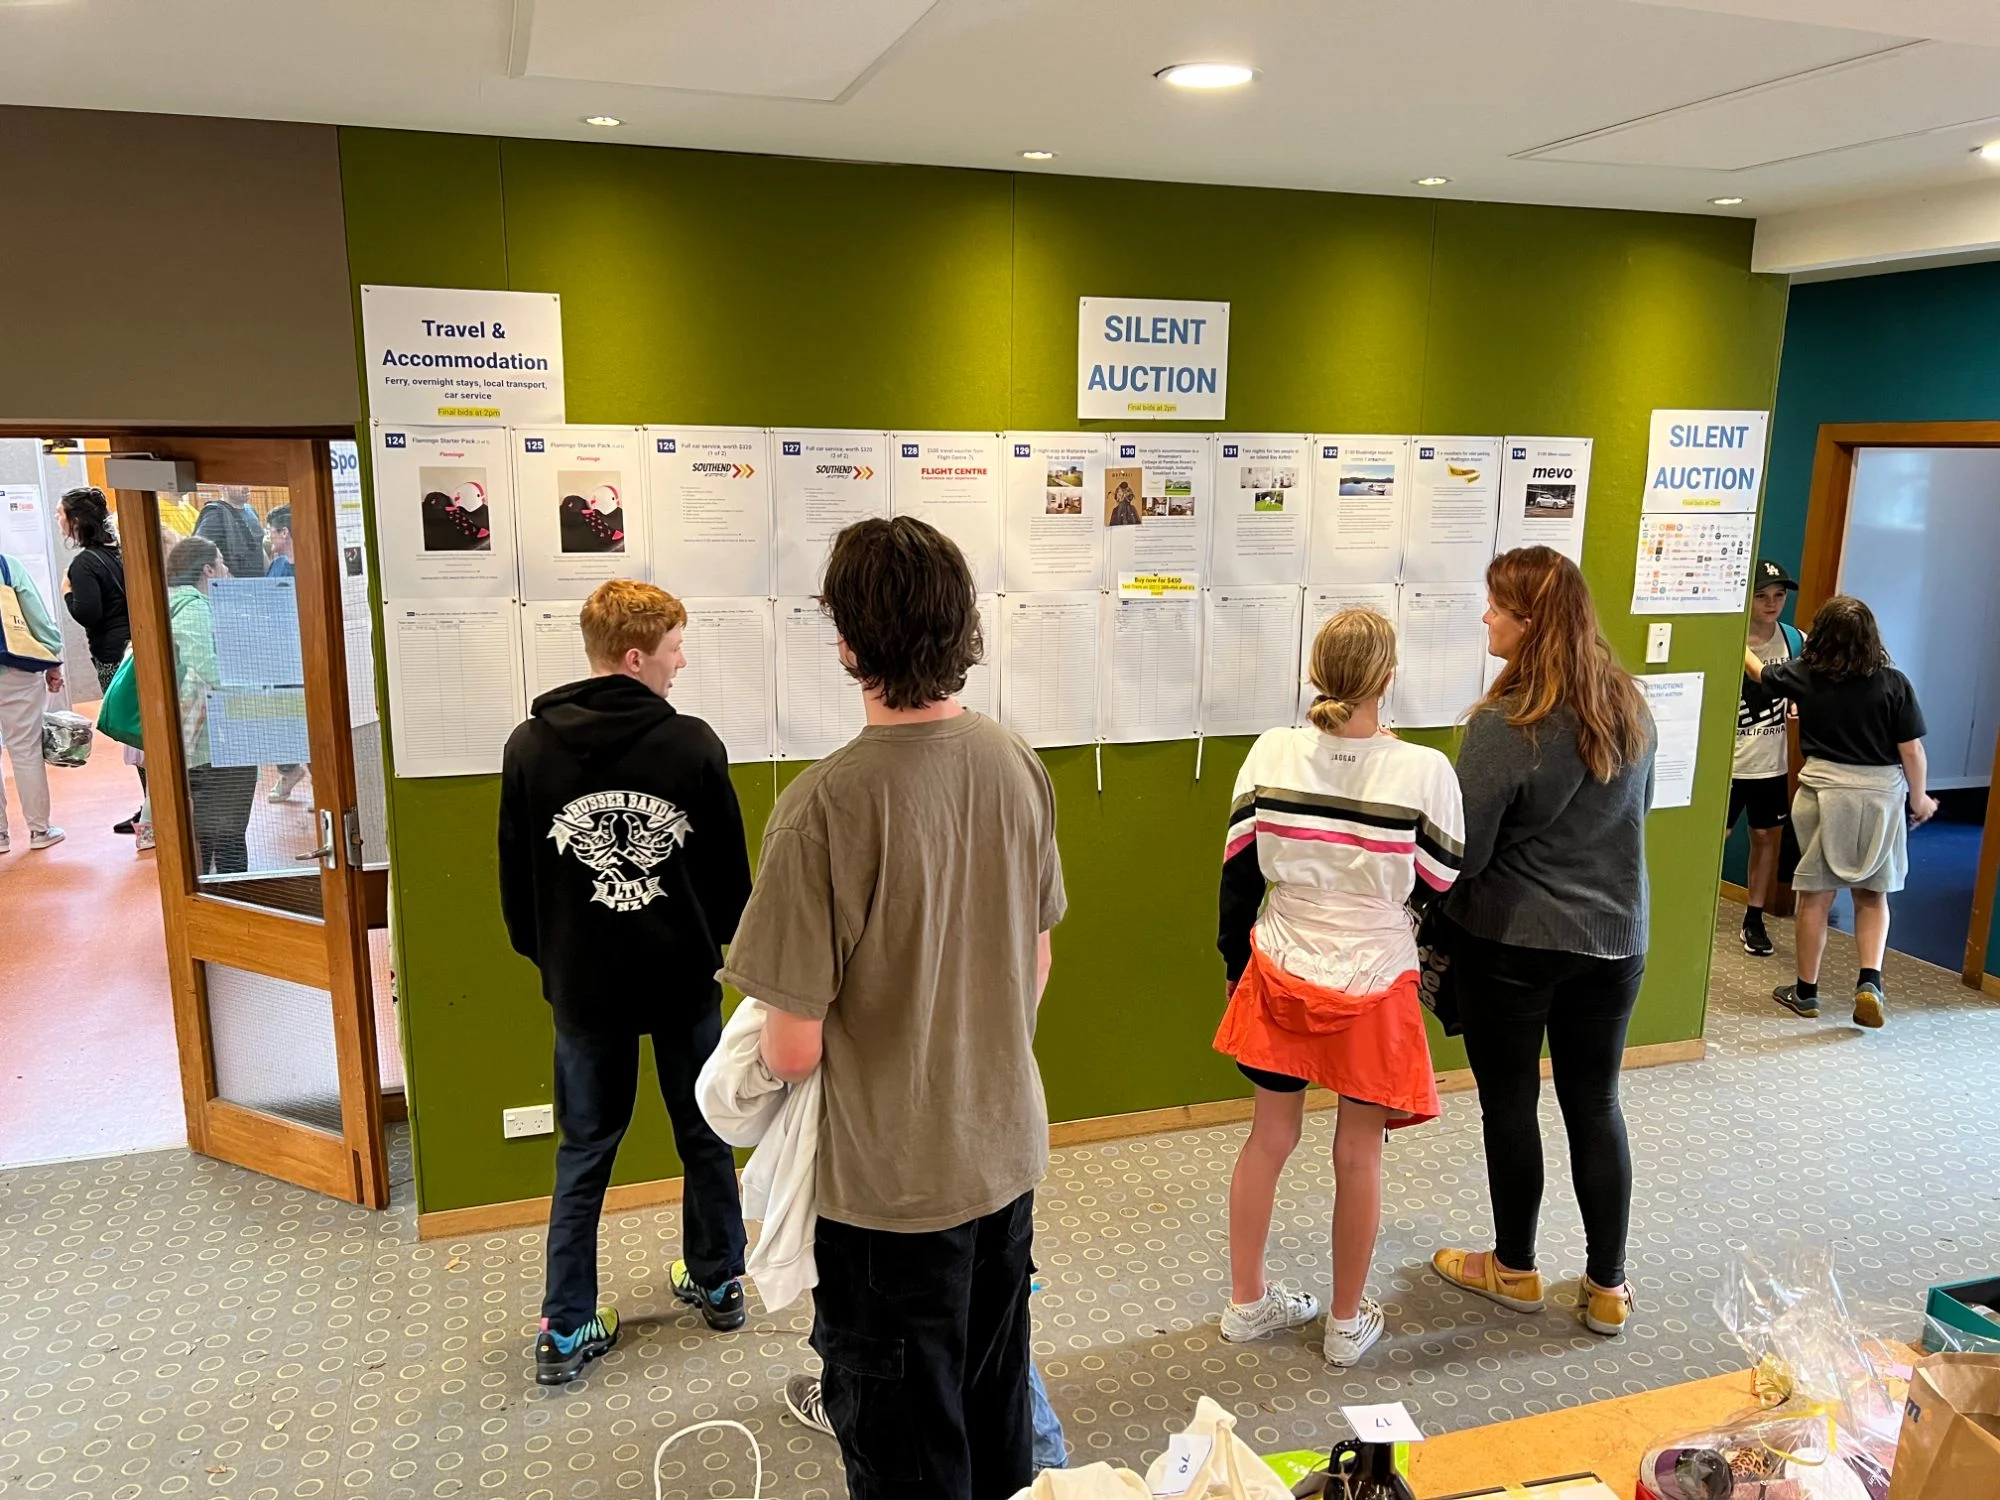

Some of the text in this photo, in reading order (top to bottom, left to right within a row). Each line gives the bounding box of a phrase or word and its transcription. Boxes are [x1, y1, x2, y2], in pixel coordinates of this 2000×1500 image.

[421, 319, 506, 339] Travel &
[1104, 315, 1207, 345] SILENT
[382, 349, 549, 371] Accommodation
[385, 376, 548, 390] Ferry, overnight stays, local transport,
[1087, 364, 1217, 394] AUCTION
[444, 391, 492, 400] car service
[438, 407, 455, 416] Final
[457, 407, 473, 416] bids
[483, 408, 500, 418] 2pm
[1127, 403, 1177, 413] Final bids at 2pm
[386, 436, 404, 446] 124
[412, 437, 439, 445] Flamingo
[1669, 424, 1750, 449] SILENT
[526, 441, 544, 450] 125
[658, 441, 675, 451] 126
[783, 444, 800, 453] 127
[903, 446, 918, 455] 128
[1015, 446, 1030, 456] 129
[1121, 447, 1135, 456] 130
[1224, 447, 1237, 456] 131
[1324, 448, 1337, 457] 132
[1513, 450, 1526, 458] 134
[330, 448, 357, 475] Spo
[692, 462, 732, 472] SOUTHEND
[815, 464, 853, 474] SOUTHEND
[921, 467, 988, 476] FLIGHT CENTRE
[1532, 467, 1573, 479] mevo
[1653, 466, 1755, 490] AUCTION
[1764, 562, 1780, 576] LA
[1134, 576, 1145, 584] Buy
[1763, 656, 1791, 666] GELES
[1646, 682, 1684, 690] STRUCTIONS
[1737, 725, 1786, 736] ALIFORNA
[628, 793, 670, 819] BAND
[614, 881, 644, 900] LTD
[616, 899, 642, 913] NZ
